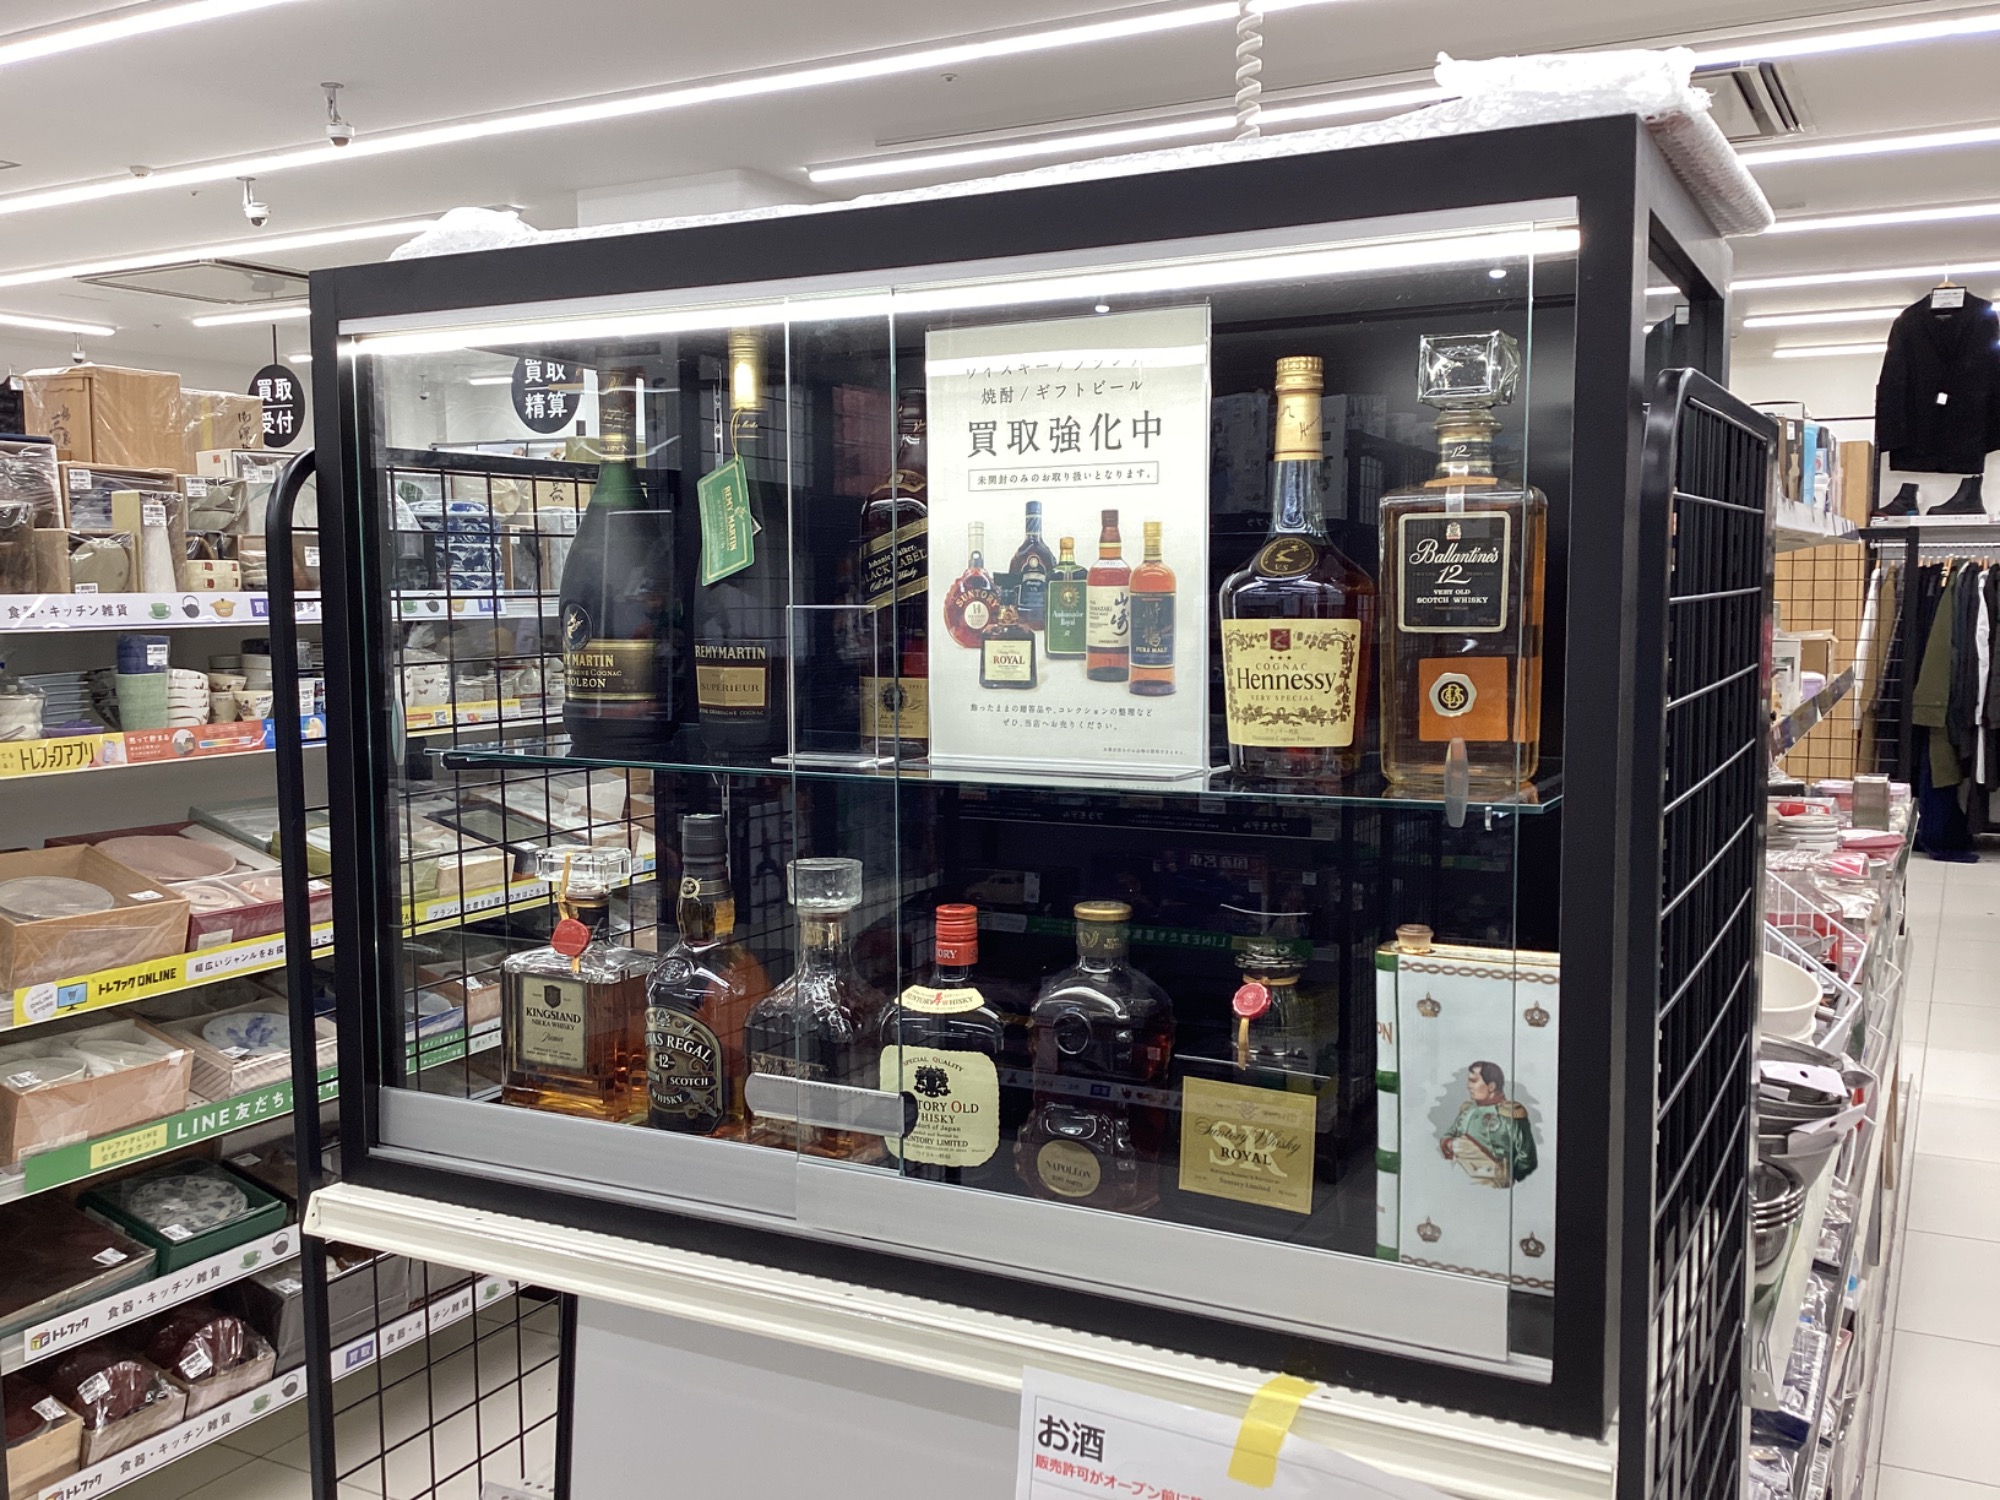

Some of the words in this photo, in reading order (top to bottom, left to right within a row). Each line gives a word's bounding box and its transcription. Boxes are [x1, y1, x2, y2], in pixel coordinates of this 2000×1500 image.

[524, 358, 567, 384] 買取
[256, 378, 293, 402] 買取
[525, 391, 568, 419] 精算
[262, 410, 294, 435] 受付
[967, 410, 1163, 458] 買取強化中
[1450, 445, 1471, 458] 12
[977, 468, 1151, 486] 未開封のみのお取り扱いとなります。
[1409, 538, 1499, 565] Ballantine's
[1435, 564, 1471, 584] 12
[956, 589, 1000, 608] SUNTORY
[1416, 596, 1450, 604] SCOTCH
[1453, 596, 1488, 604] WHISKY
[572, 654, 614, 667] MARTIN
[993, 655, 1026, 665] ROYAL
[1255, 662, 1309, 671] COGNAC
[1236, 667, 1337, 694] Hennessy
[1275, 694, 1315, 702] SPECIAL
[1002, 719, 1118, 731] ぜひ、当店へお売りください。
[936, 949, 957, 959] ORY
[137, 968, 177, 987] ONLINE
[942, 996, 974, 1006] WHISKY
[526, 1007, 581, 1023] KINGSLAND
[532, 1019, 551, 1027] NIKKA
[552, 1021, 575, 1031] WHISKY
[667, 1034, 712, 1063] REGAL
[658, 1053, 669, 1068] 12
[903, 1057, 928, 1067] SPECIAL
[932, 1056, 964, 1072] QUALITY
[669, 1075, 708, 1086] SCOTCH
[651, 1087, 684, 1105] WHISKY
[177, 1087, 294, 1140] LINE友だち
[917, 1100, 947, 1113] TORY
[951, 1100, 979, 1114] OLD
[921, 1113, 955, 1124] HISKY
[936, 1139, 969, 1148] LIMITED
[1194, 1116, 1249, 1147] Suntory
[1252, 1128, 1301, 1157] Whisky
[1221, 1146, 1272, 1166] ROYAL
[1045, 1160, 1091, 1179] NAPOLEON
[52, 1317, 90, 1341] トレファク
[107, 1265, 221, 1321] 食器・キッチン雑貨
[386, 1297, 470, 1346] 食器・キチン雑貨
[1038, 1414, 1106, 1463] お酒
[65, 1473, 103, 1498] トレファク
[119, 1412, 232, 1475] 食器・キッチン雑貨
